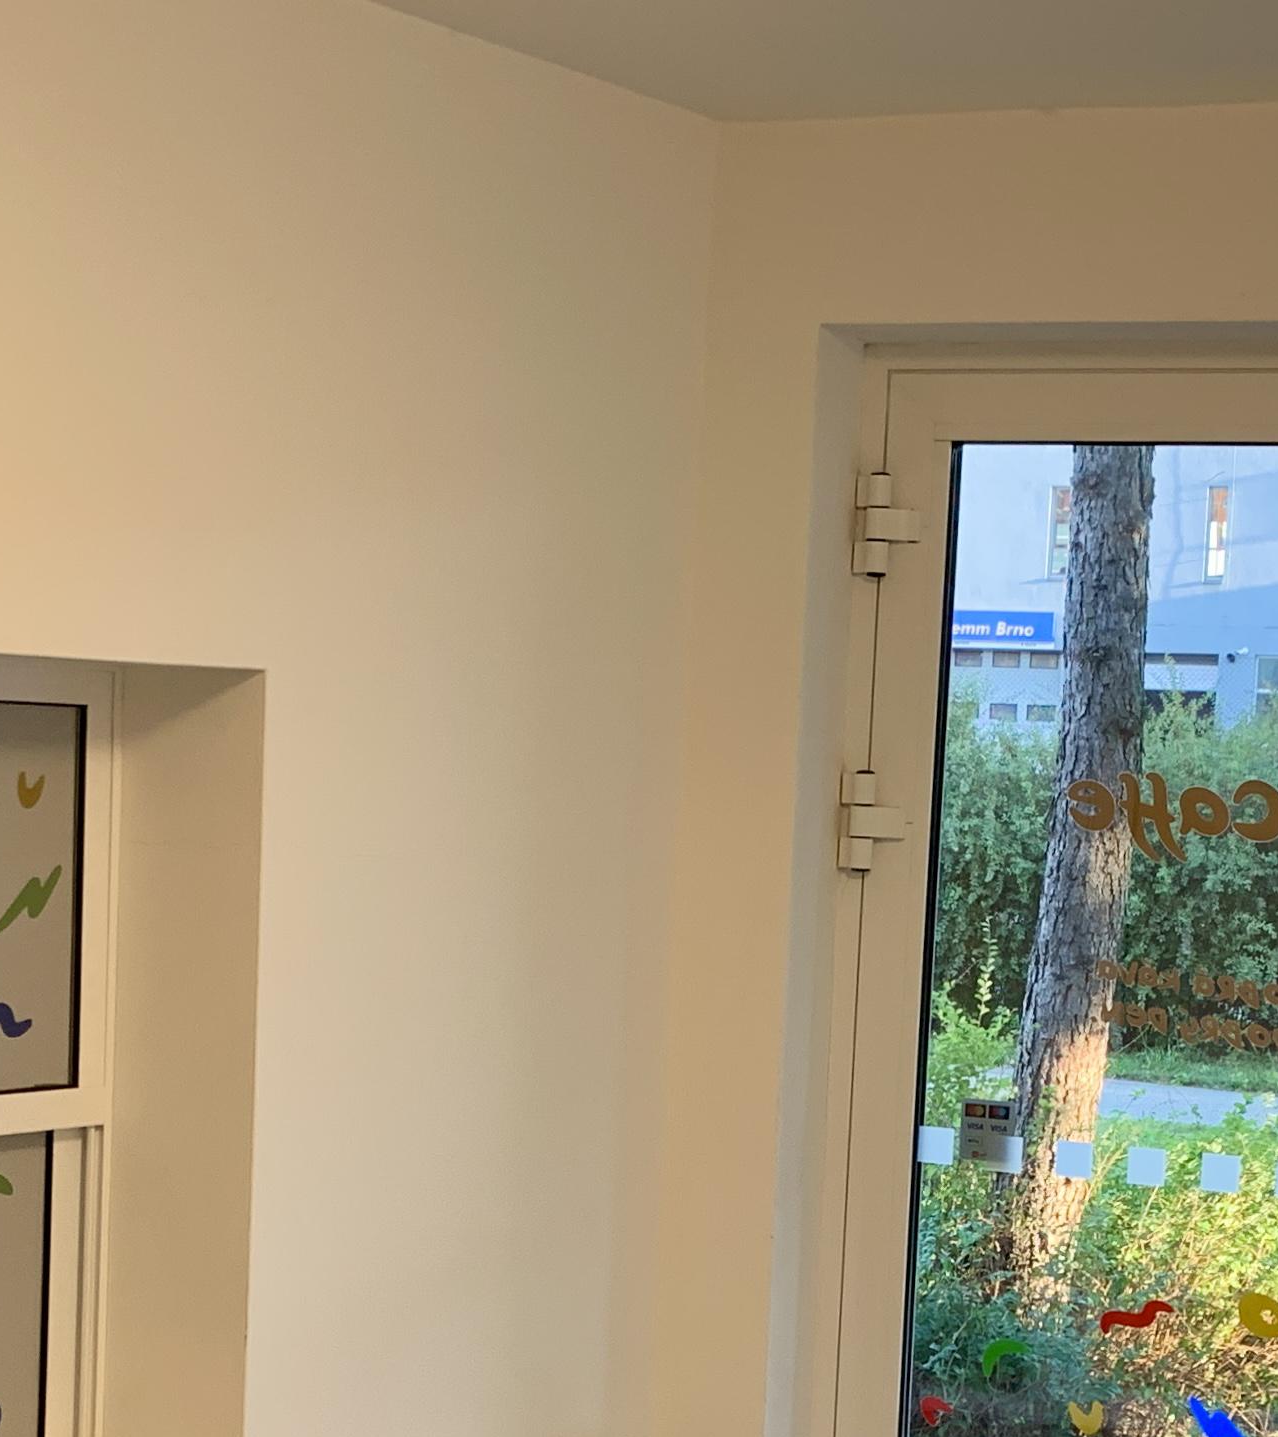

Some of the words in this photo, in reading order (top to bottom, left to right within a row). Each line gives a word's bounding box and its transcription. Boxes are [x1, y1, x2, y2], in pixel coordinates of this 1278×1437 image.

[995, 620, 1035, 637] Brno
[967, 1122, 984, 1130] VISA
[990, 1124, 1007, 1132] VISA
